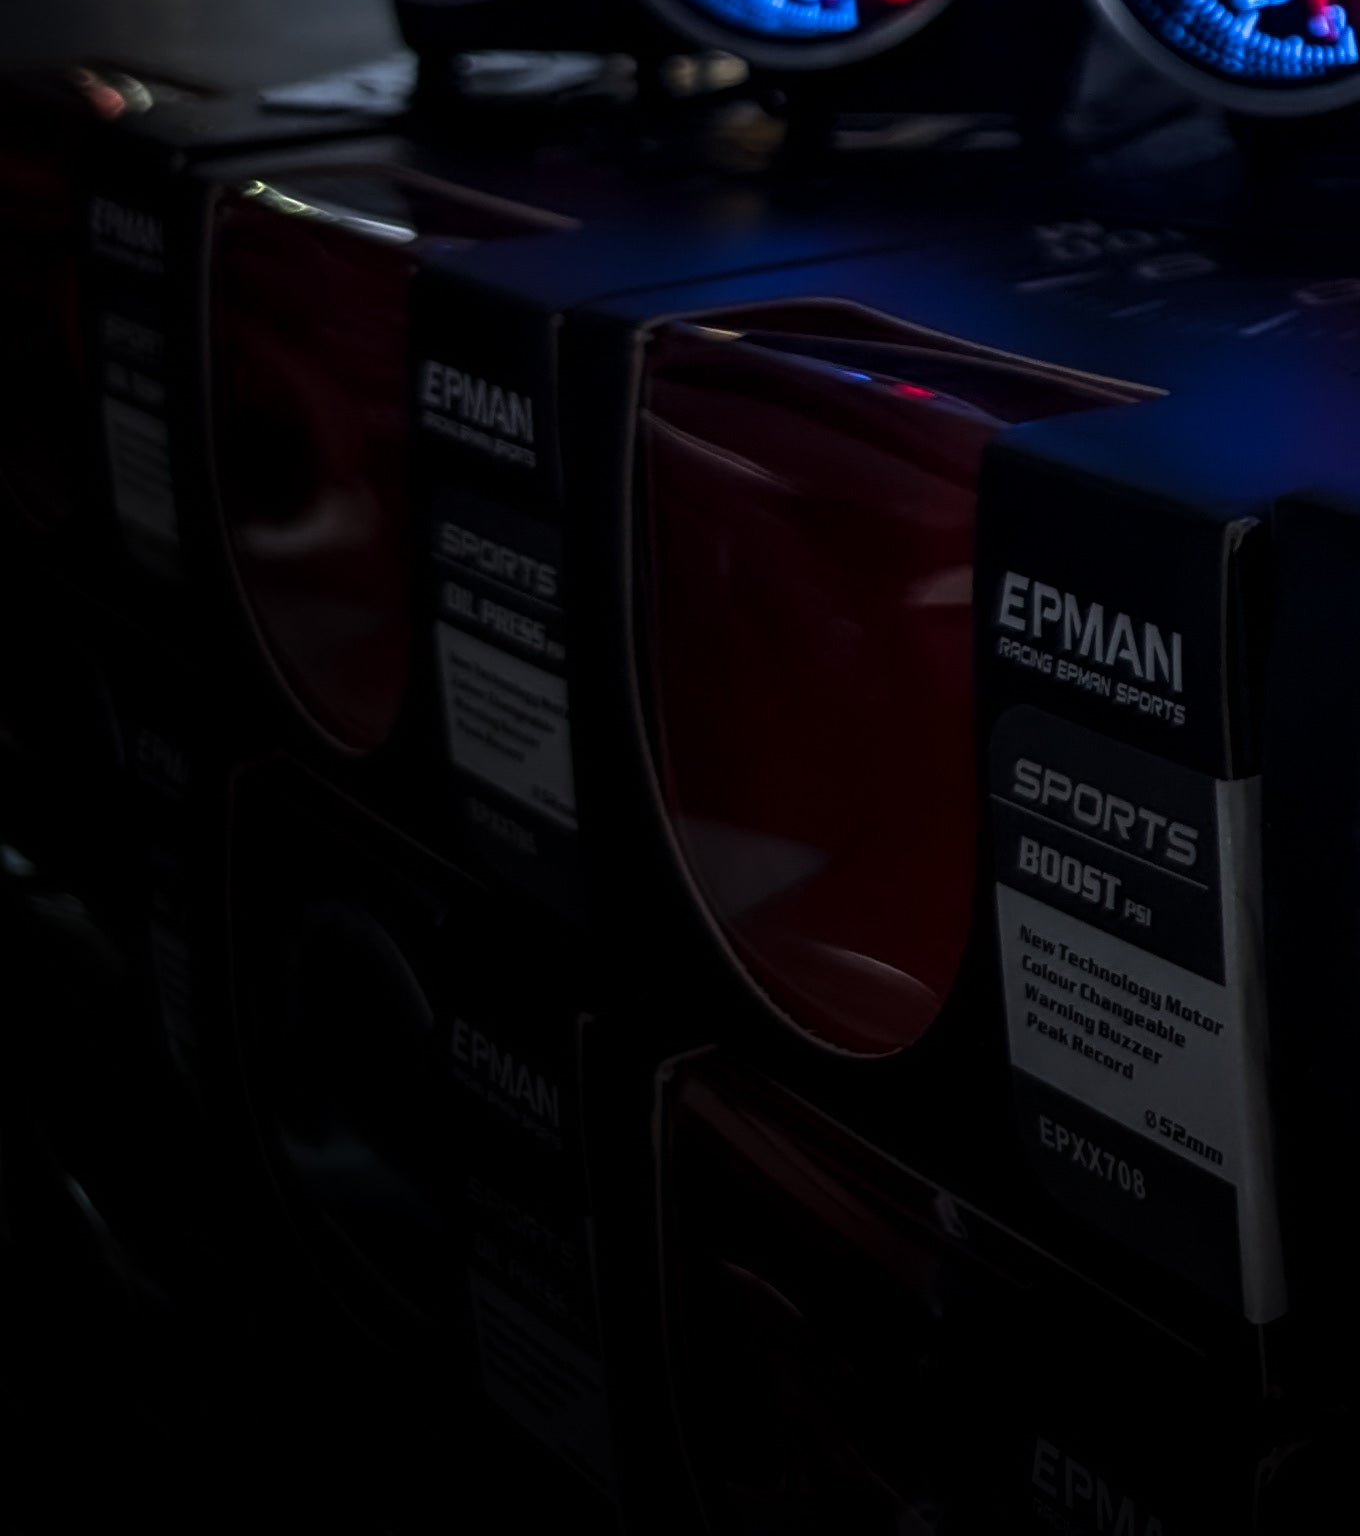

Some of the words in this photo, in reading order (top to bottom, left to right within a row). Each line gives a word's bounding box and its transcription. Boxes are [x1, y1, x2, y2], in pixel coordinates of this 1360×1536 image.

[419, 359, 535, 445] EPMAN
[441, 520, 558, 598] SPORTS
[998, 569, 1184, 693] EPMAN
[1113, 681, 1187, 728] SPORTS
[1012, 757, 1199, 867] SPORTS
[1018, 834, 1122, 912] BOOST
[1020, 924, 1056, 955] New
[1058, 943, 1163, 1012] Technology
[1165, 994, 1225, 1037] Motor
[1021, 954, 1079, 997] Colour
[1080, 982, 1187, 1050] Changeable
[1024, 982, 1097, 1036] Warning
[1098, 1018, 1163, 1066] Buzzer
[1026, 1011, 1070, 1047] Peak
[1071, 1035, 1135, 1080] Record
[1037, 1113, 1149, 1201] EPXX708
